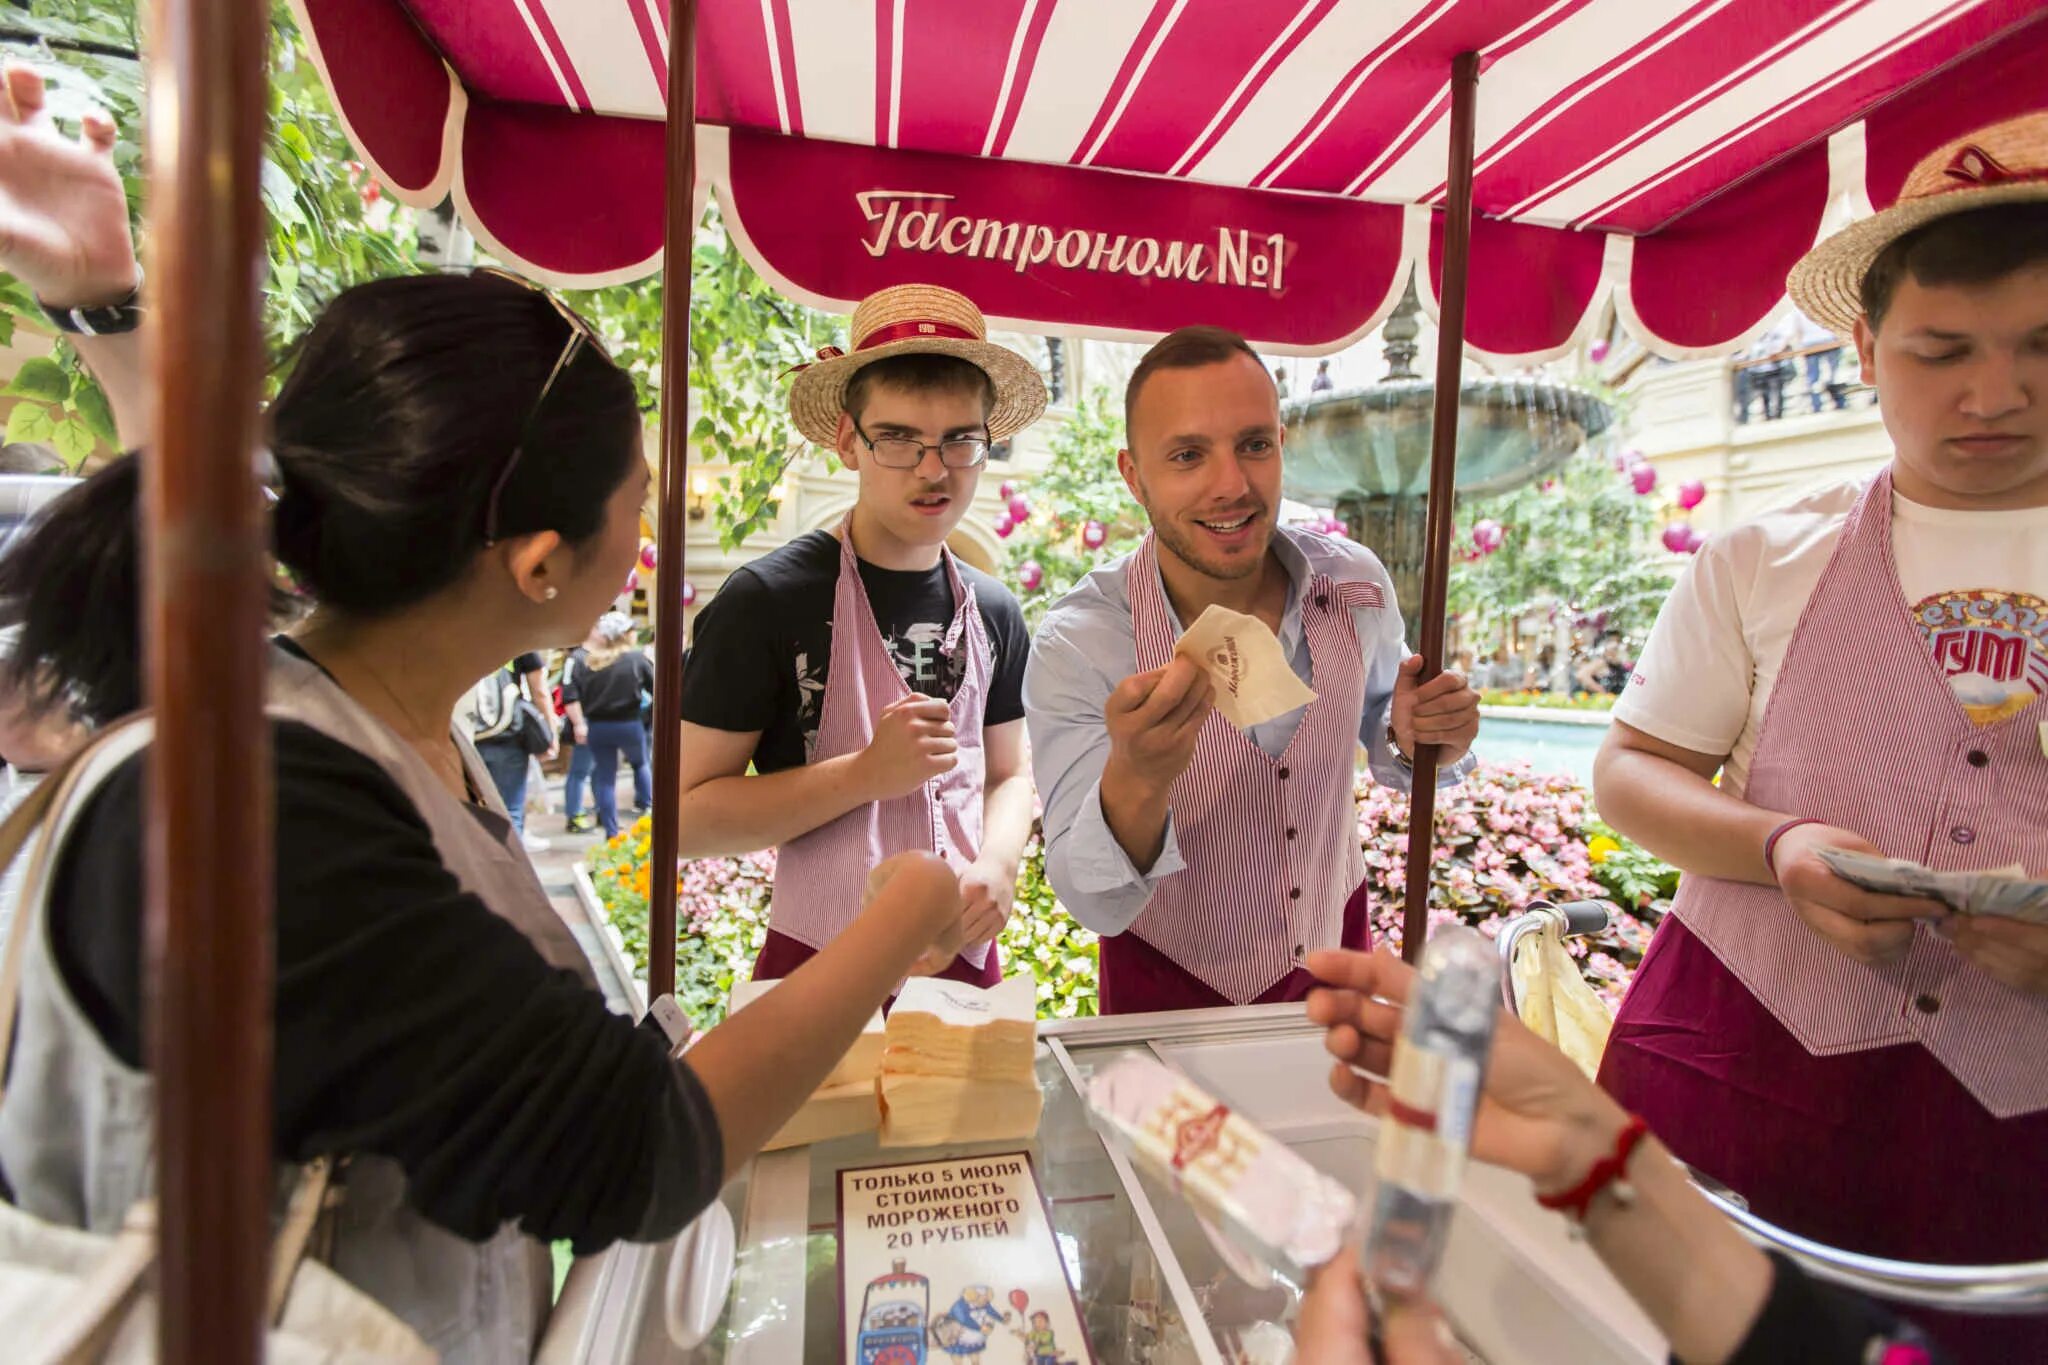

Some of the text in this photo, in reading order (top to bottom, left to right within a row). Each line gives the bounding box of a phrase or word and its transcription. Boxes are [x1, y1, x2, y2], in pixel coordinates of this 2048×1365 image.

[856, 190, 1284, 289] Гастроном №1
[852, 1162, 1022, 1191] ТОЛЬКО 5 ИЮЛЯ
[876, 1182, 1005, 1208] СТОИМОСТЬ
[867, 1199, 1020, 1229] МОРОЖЕНОГО
[887, 1220, 1009, 1249] 20 РУБЛЕЙ
